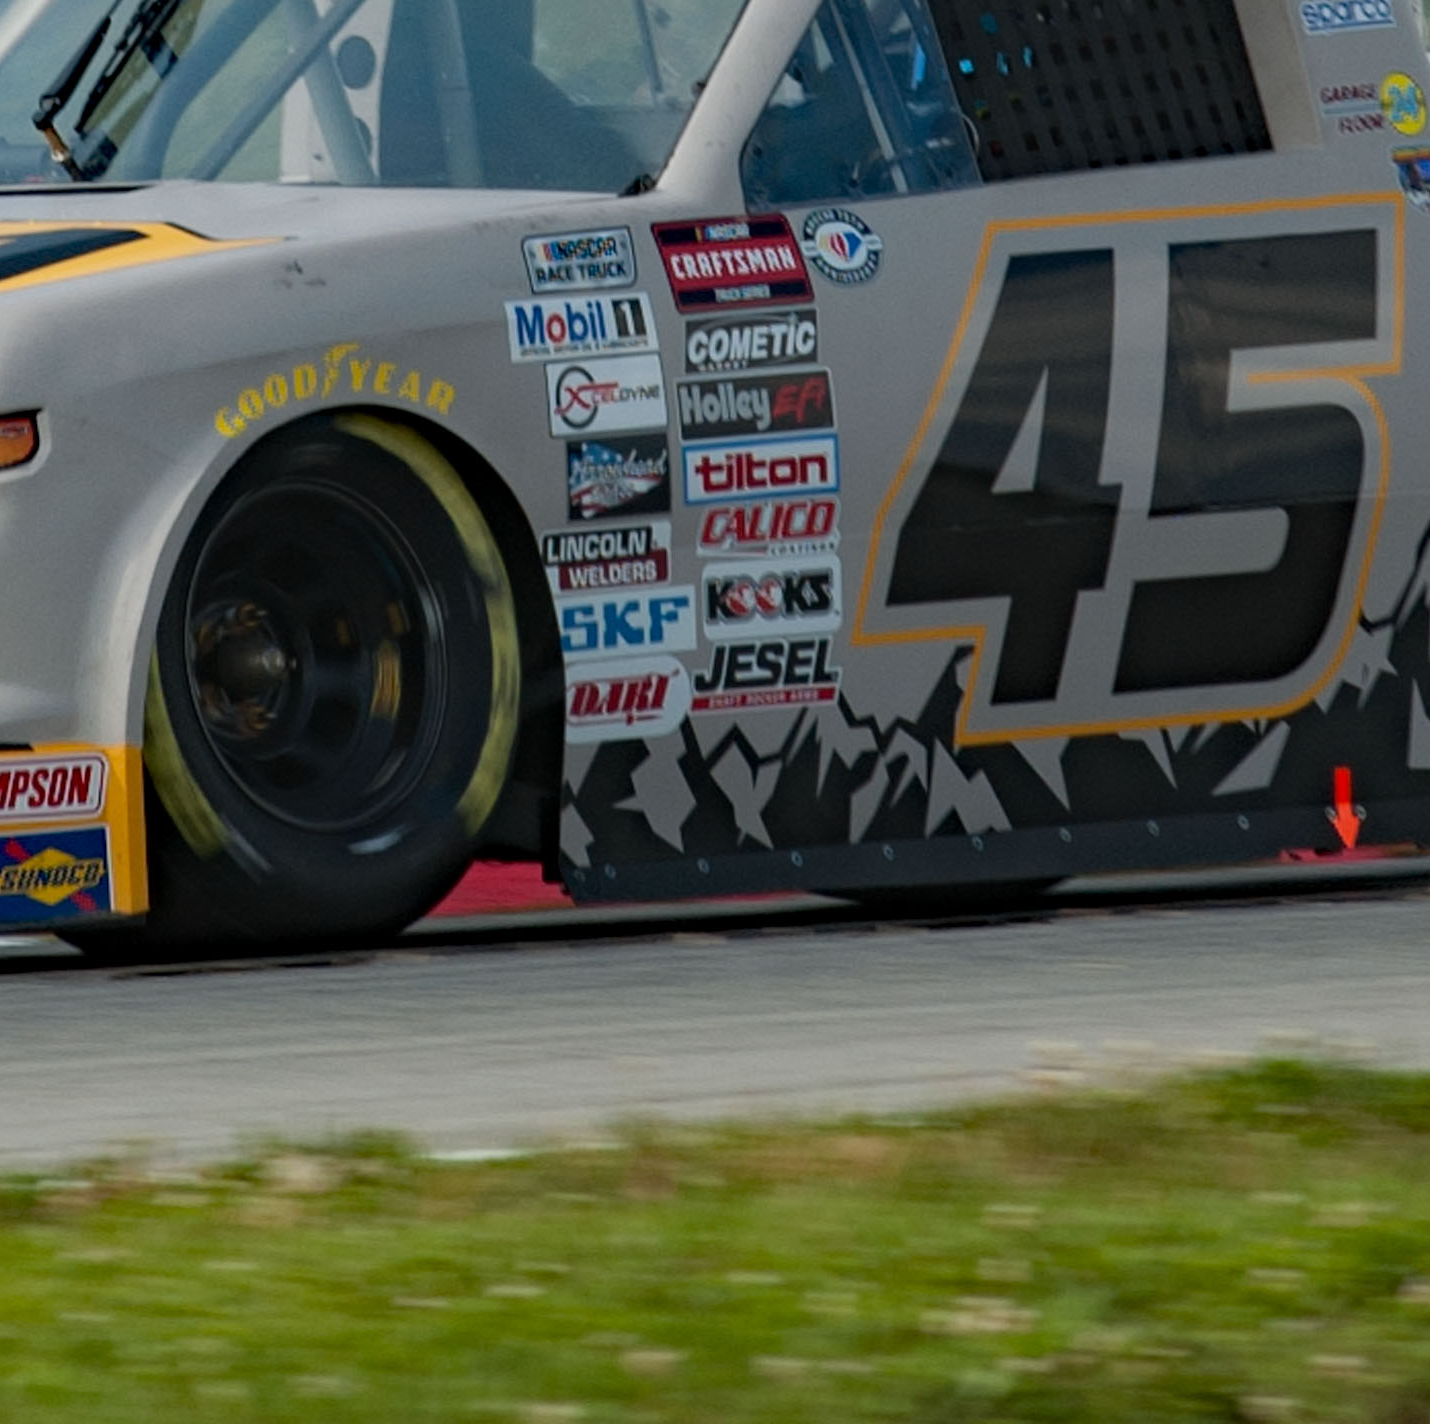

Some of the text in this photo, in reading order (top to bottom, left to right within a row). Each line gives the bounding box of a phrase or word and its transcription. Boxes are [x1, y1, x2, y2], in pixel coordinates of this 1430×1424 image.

[535, 259, 627, 283] RACE TRUCK
[553, 237, 618, 262] NASCAR
[670, 245, 797, 280] CRAFTSMAN
[515, 300, 607, 348] Mobil
[687, 312, 817, 366] COMETIC
[215, 341, 456, 438] GOODYEAR
[678, 381, 772, 432] Holley
[695, 452, 828, 493] tilton
[884, 227, 1379, 708] 45
[701, 499, 837, 545] CALICO
[546, 530, 647, 564] LINCOLN
[568, 559, 658, 589] WELDERS
[706, 569, 835, 624] KOOKS
[561, 595, 690, 653] SKF
[694, 639, 840, 693] JESEL
